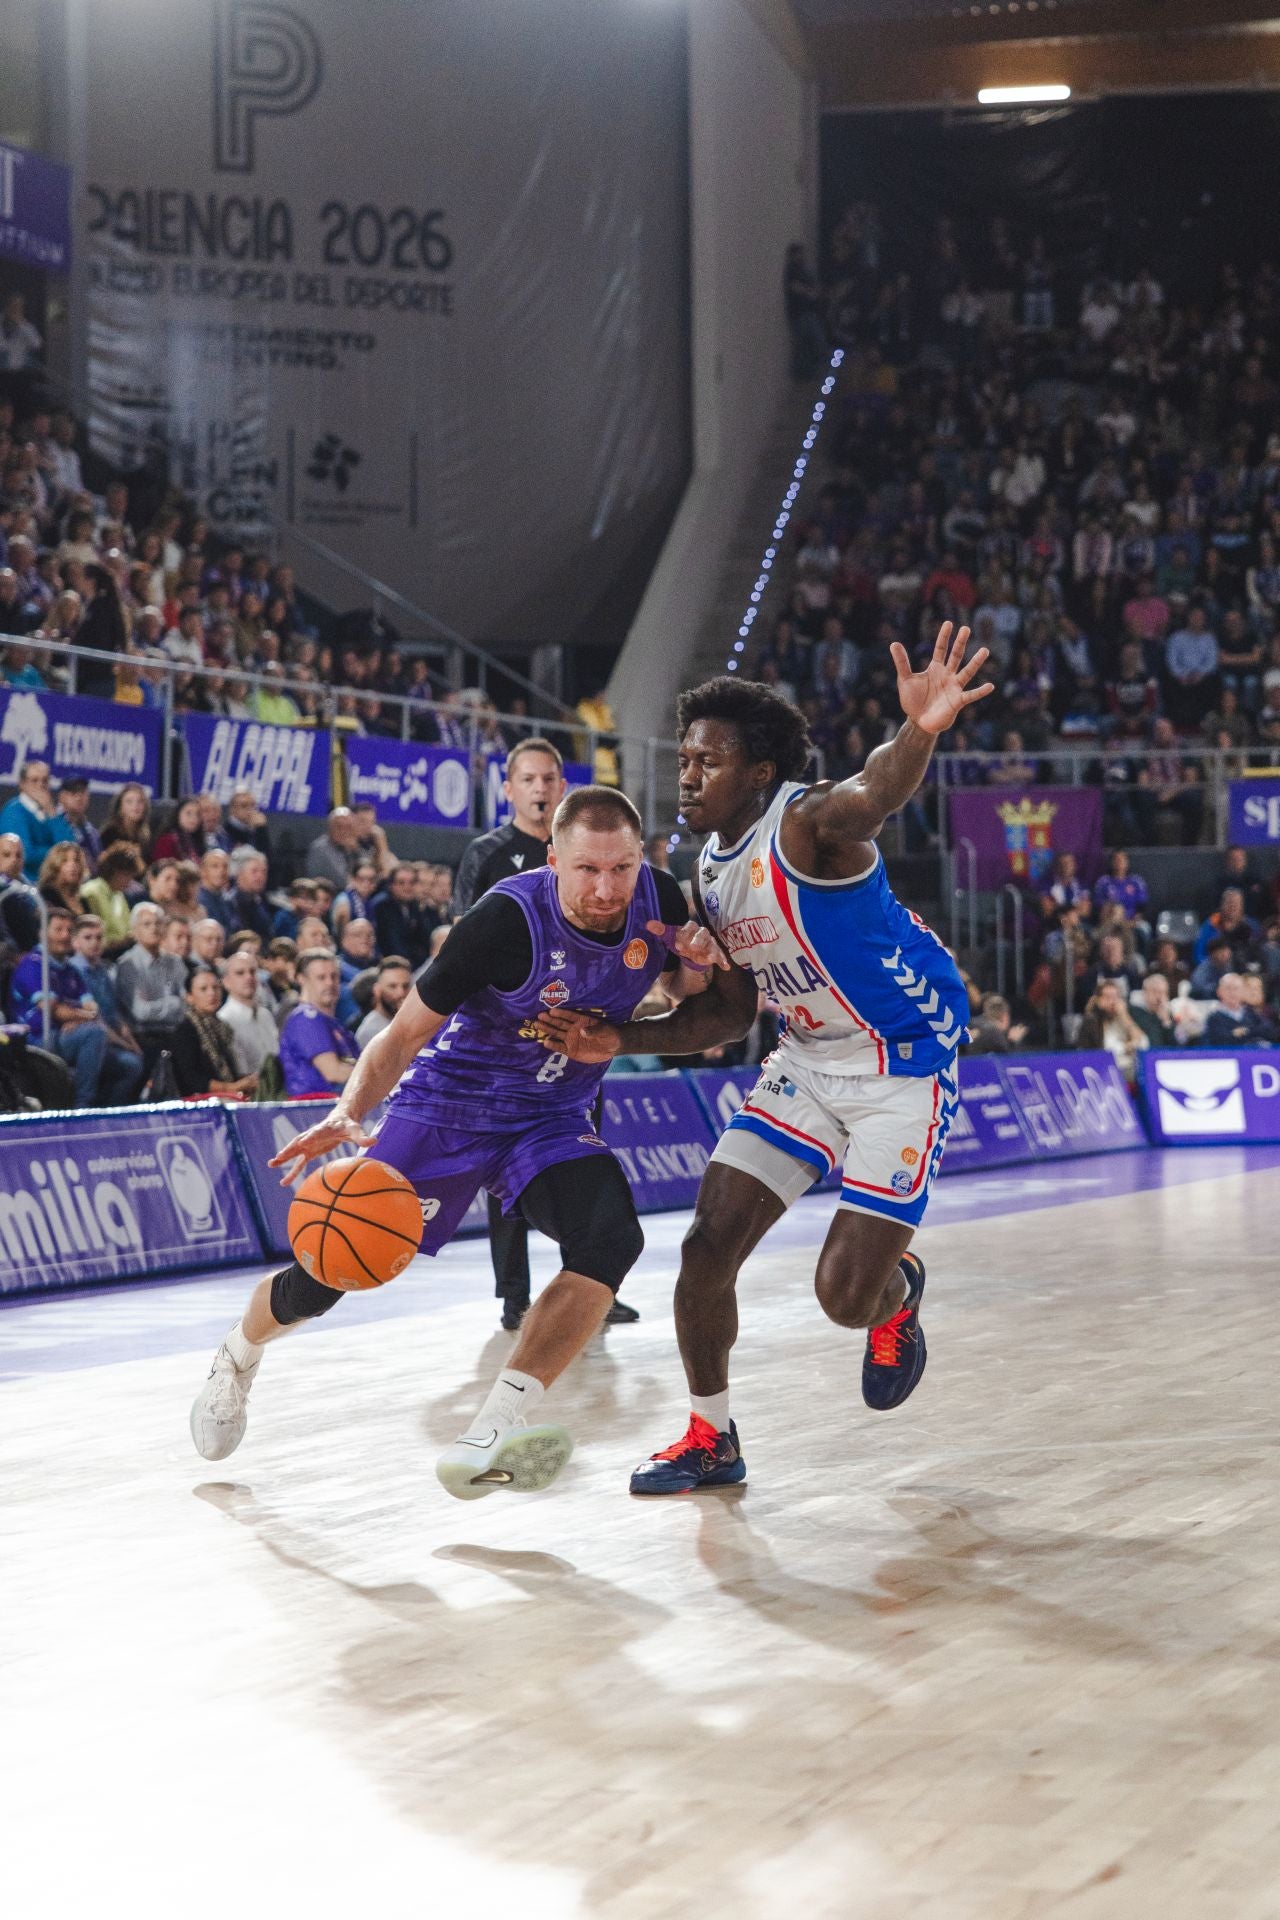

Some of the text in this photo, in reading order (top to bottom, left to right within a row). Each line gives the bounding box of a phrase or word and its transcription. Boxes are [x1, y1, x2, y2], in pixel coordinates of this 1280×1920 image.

[318, 200, 454, 272] 2026
[201, 719, 316, 814] ALCOPAL
[535, 1051, 569, 1084] 8
